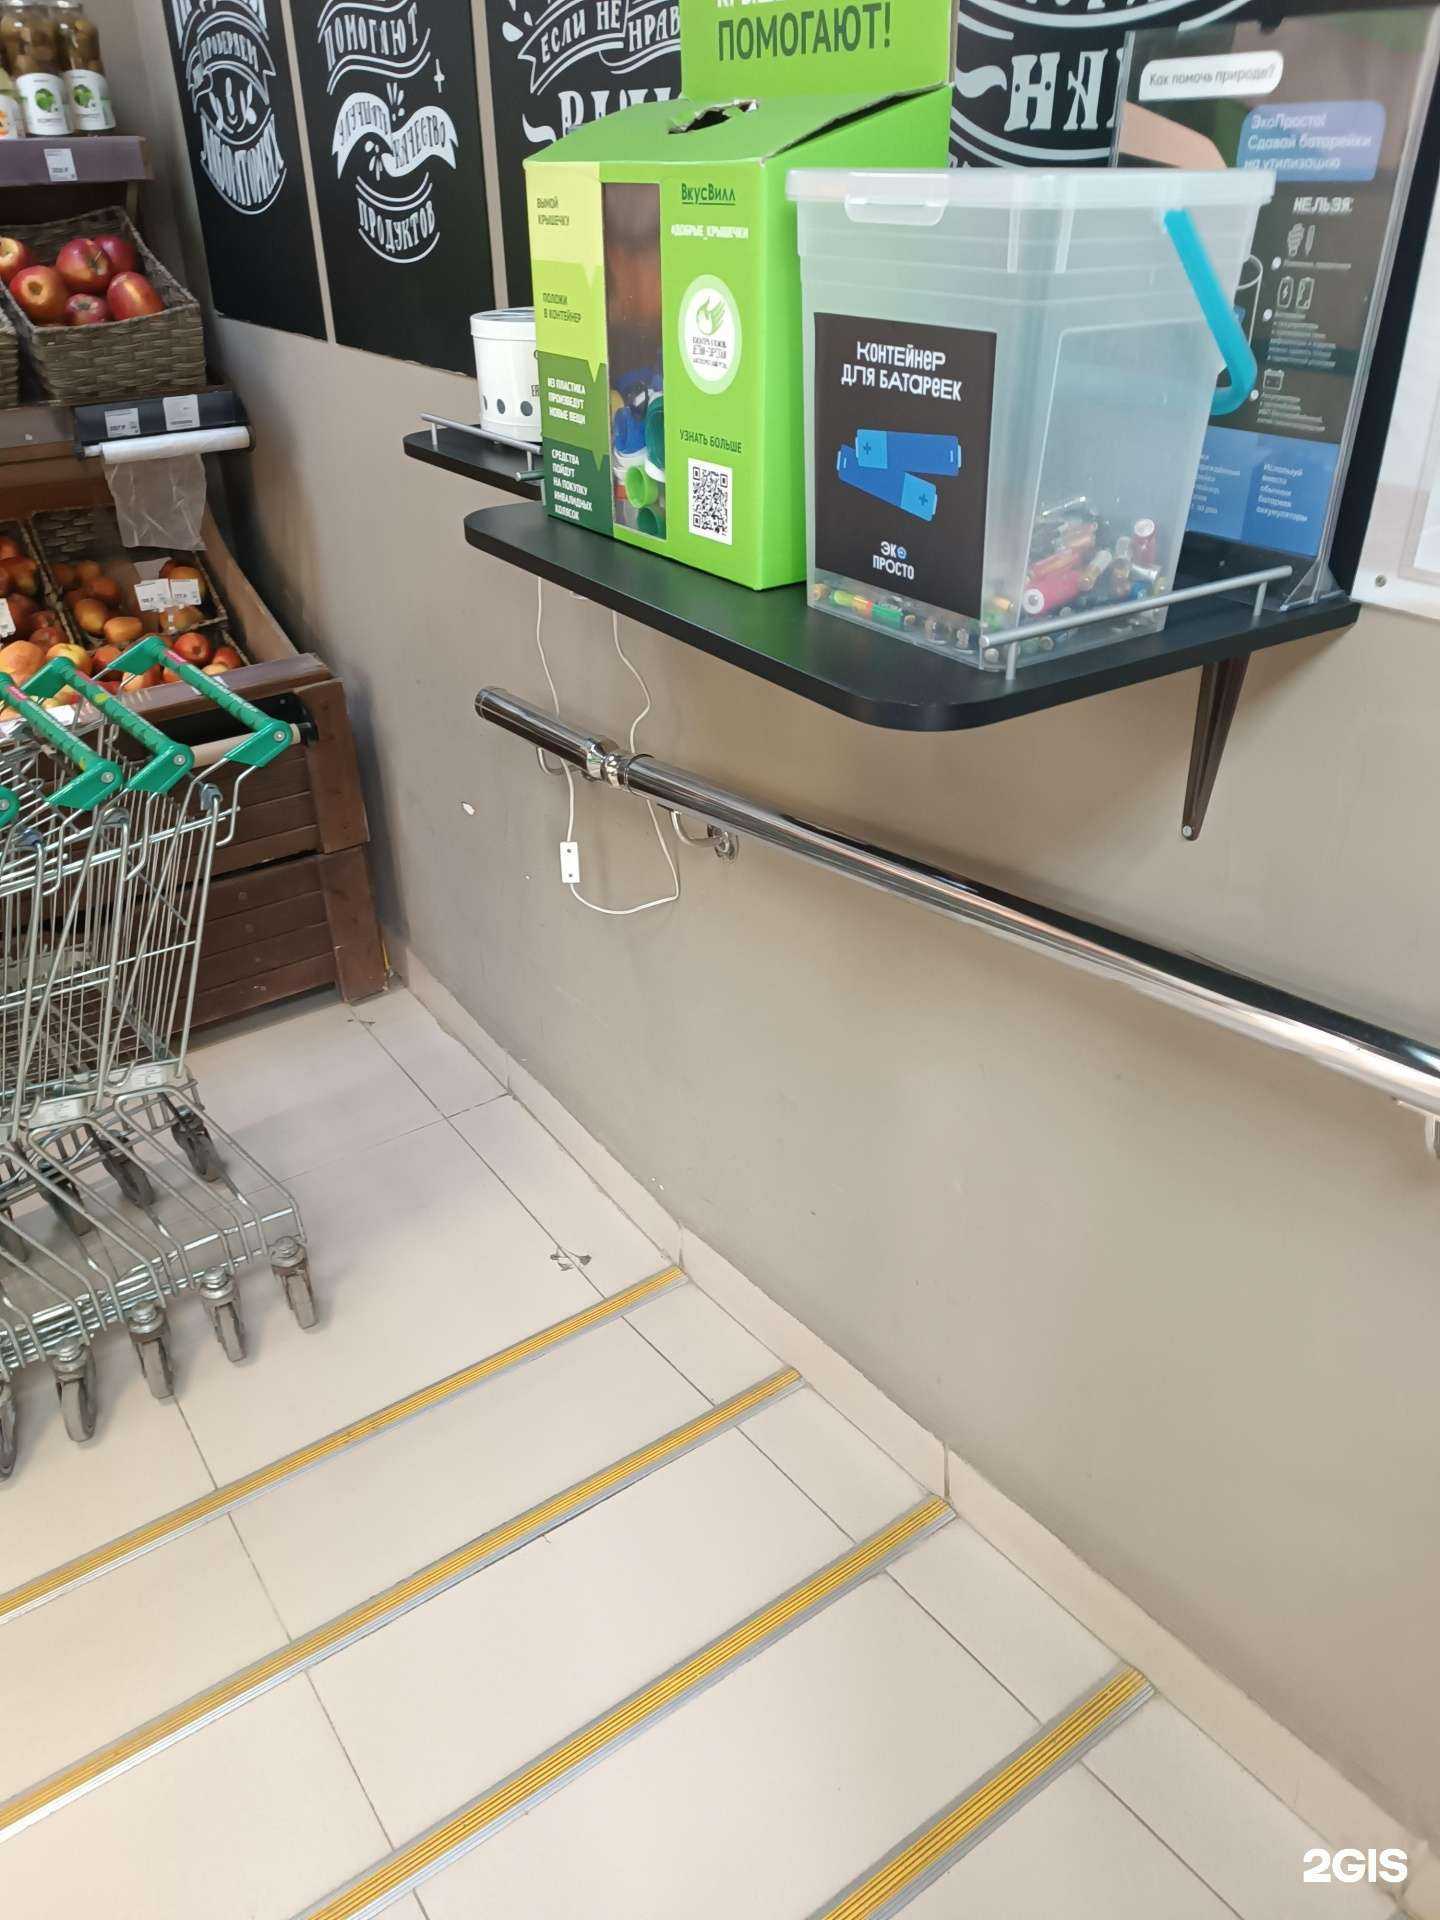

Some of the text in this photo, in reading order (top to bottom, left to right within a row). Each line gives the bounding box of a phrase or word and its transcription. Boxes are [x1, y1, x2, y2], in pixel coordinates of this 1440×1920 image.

[324, 3, 418, 71] ПОМОГАЮТ
[541, 0, 622, 63] ЕСЛИ НЕ
[718, 2, 891, 61] ПОМОГАЮТ!
[1150, 72, 1169, 86] Как
[681, 183, 736, 204] ВкусВилл
[357, 198, 435, 253] ПРОДУКТОВ
[841, 363, 876, 387] ДЛЯ
[679, 428, 743, 454] УЗНАТЬ БОЛЬШЕ
[872, 554, 915, 581] ПРОСТО
